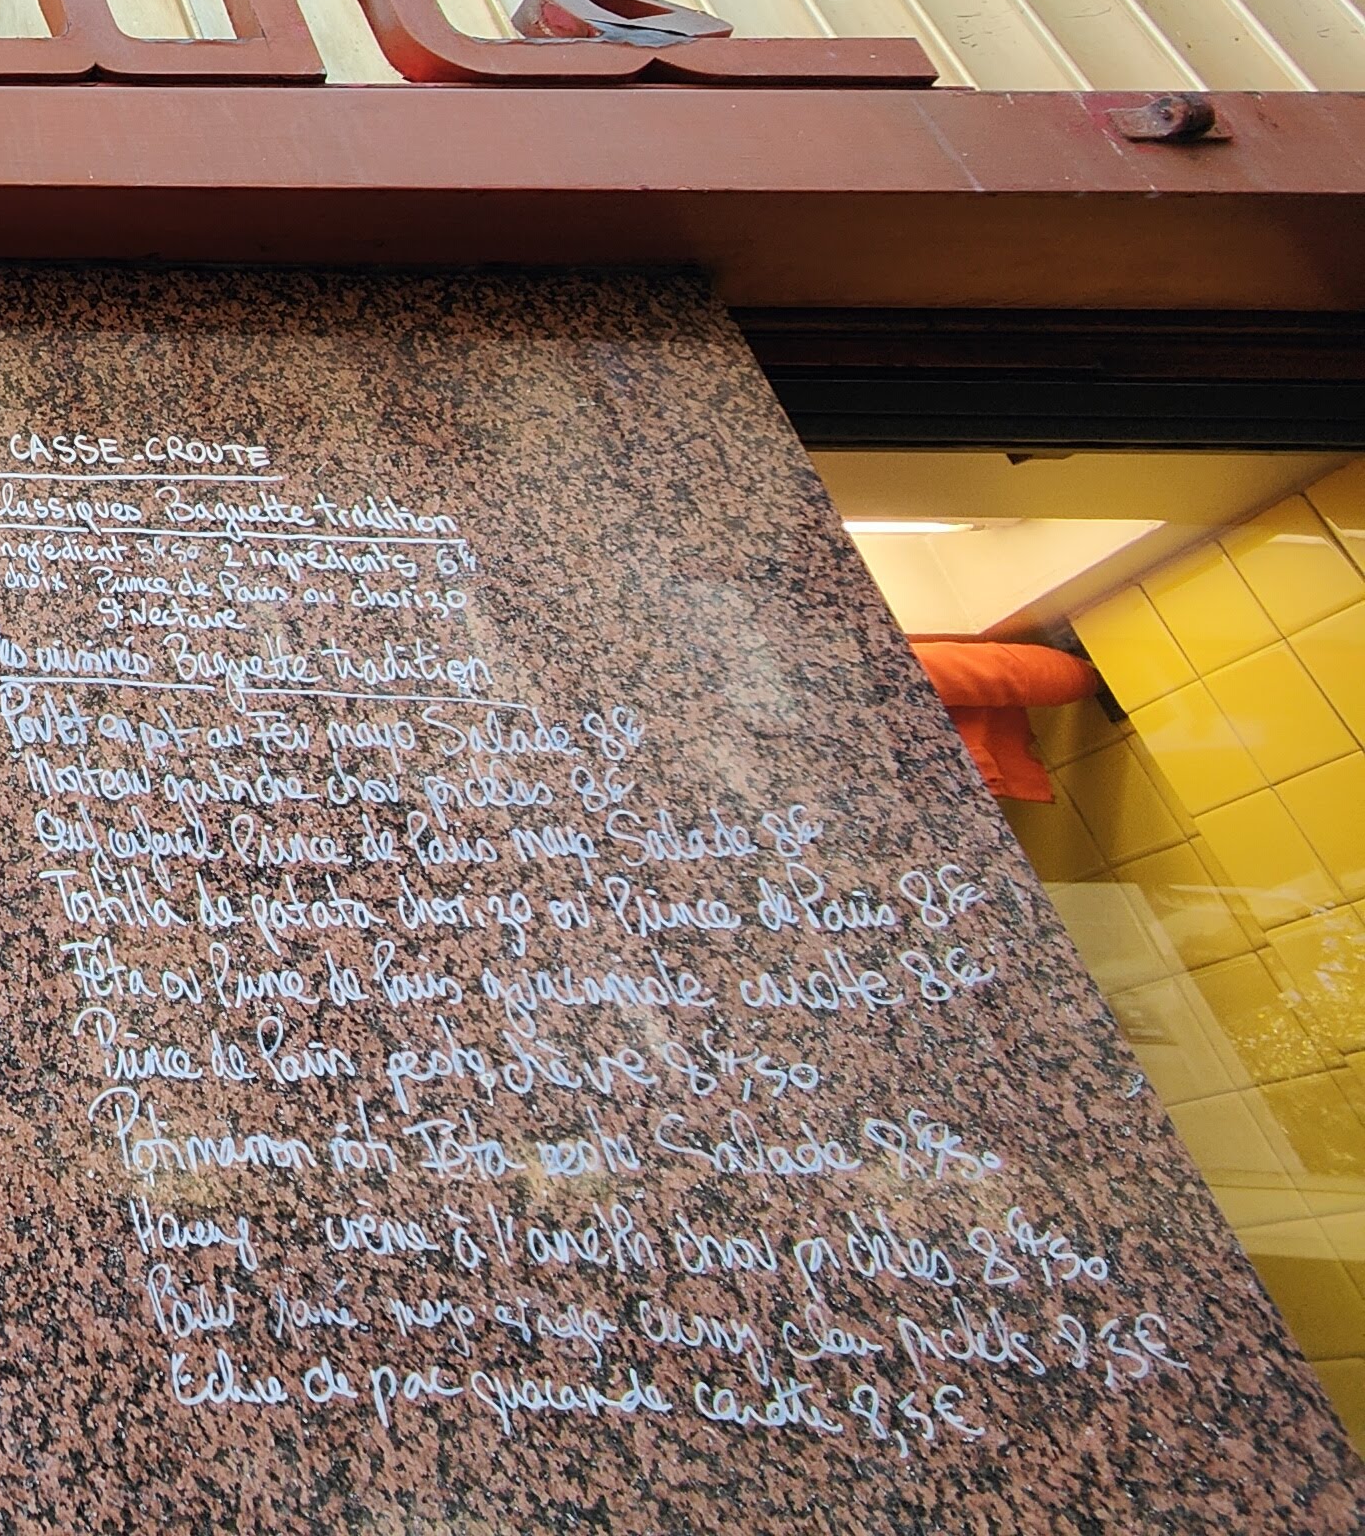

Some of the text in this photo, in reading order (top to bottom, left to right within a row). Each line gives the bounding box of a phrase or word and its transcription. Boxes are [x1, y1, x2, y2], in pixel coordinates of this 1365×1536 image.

[156, 486, 315, 542] Baguette
[314, 492, 456, 532] tradition
[89, 565, 173, 594] Prince
[179, 568, 212, 596] de
[218, 570, 287, 602] Paris
[303, 588, 335, 603] ou
[351, 580, 467, 619] chorizo
[219, 544, 243, 567] 2
[244, 541, 417, 581] ingrédients
[132, 598, 247, 630] Nectaire
[35, 636, 151, 675] cuisinés
[163, 633, 322, 712] Baguette
[321, 638, 493, 694] tradition
[98, 713, 137, 743] en
[139, 706, 199, 760] pot
[207, 722, 246, 747] au
[327, 717, 416, 773] mayo
[422, 706, 581, 756] Salade
[25, 751, 151, 802] Morteau
[328, 752, 400, 806] chou
[424, 759, 553, 831] pickles
[231, 814, 352, 866] Prince
[363, 813, 396, 863] de
[407, 810, 498, 867] Paris
[511, 824, 600, 887] mayo
[605, 809, 758, 866] Salade
[39, 866, 189, 929] Tortilla
[195, 871, 245, 928] de
[251, 874, 386, 956] patata
[398, 874, 534, 958] chorizo
[549, 891, 592, 931] ou
[604, 876, 742, 939] Prince
[758, 878, 799, 932] de
[786, 863, 897, 933] Paris
[162, 971, 204, 1005] ou
[210, 941, 321, 1008] Prince
[326, 951, 370, 1007] de
[374, 940, 464, 1008] Paris
[481, 949, 716, 1039] guacamole
[739, 948, 908, 1012] carotte
[73, 1006, 204, 1081] Prince
[210, 1028, 259, 1082] de
[256, 1015, 358, 1085] Paris
[502, 1029, 659, 1095] chèvre
[656, 1109, 864, 1175] Salade
[130, 1195, 260, 1272] Hareng
[325, 1200, 441, 1254] crème
[444, 1204, 487, 1268] à
[675, 1214, 776, 1274] chou
[794, 1210, 957, 1303] pickles
[389, 1296, 475, 1357] mayo
[639, 1300, 769, 1385] curry
[303, 1357, 359, 1404] de
[369, 1365, 464, 1429] porc
[694, 1376, 843, 1434] carotte
